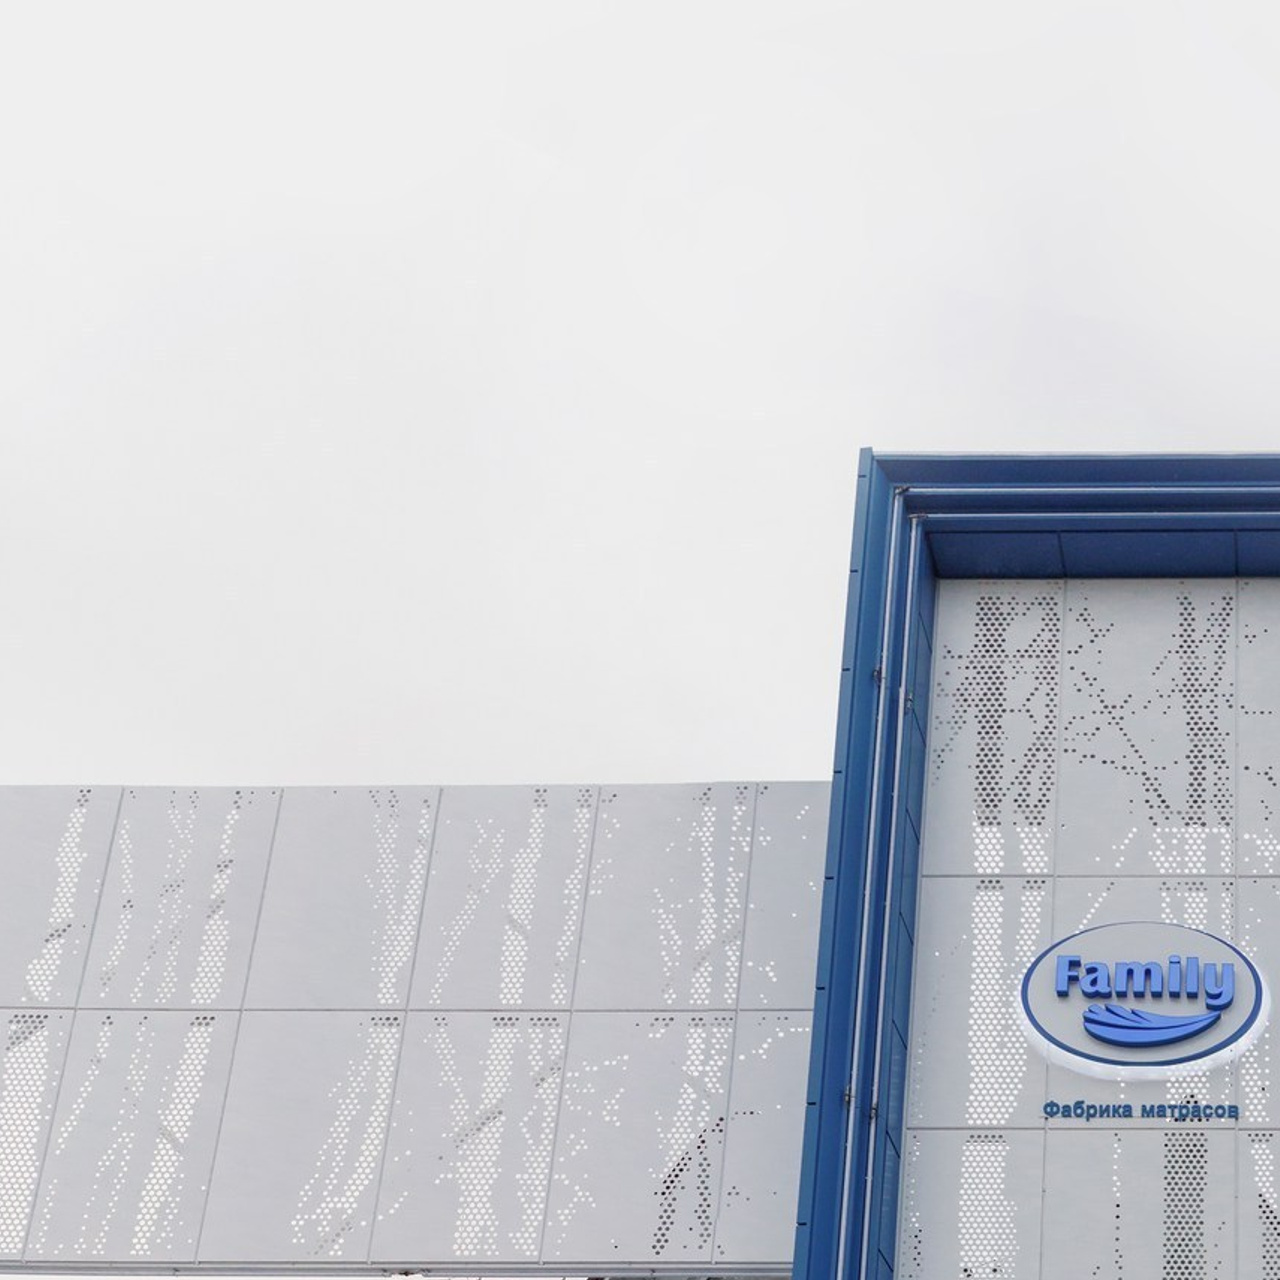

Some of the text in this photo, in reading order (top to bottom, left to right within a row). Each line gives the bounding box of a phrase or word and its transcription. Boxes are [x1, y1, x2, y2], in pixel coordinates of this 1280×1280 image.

[1055, 955, 1235, 1010] Family
[1043, 1100, 1239, 1121] Фабрика матрасов
